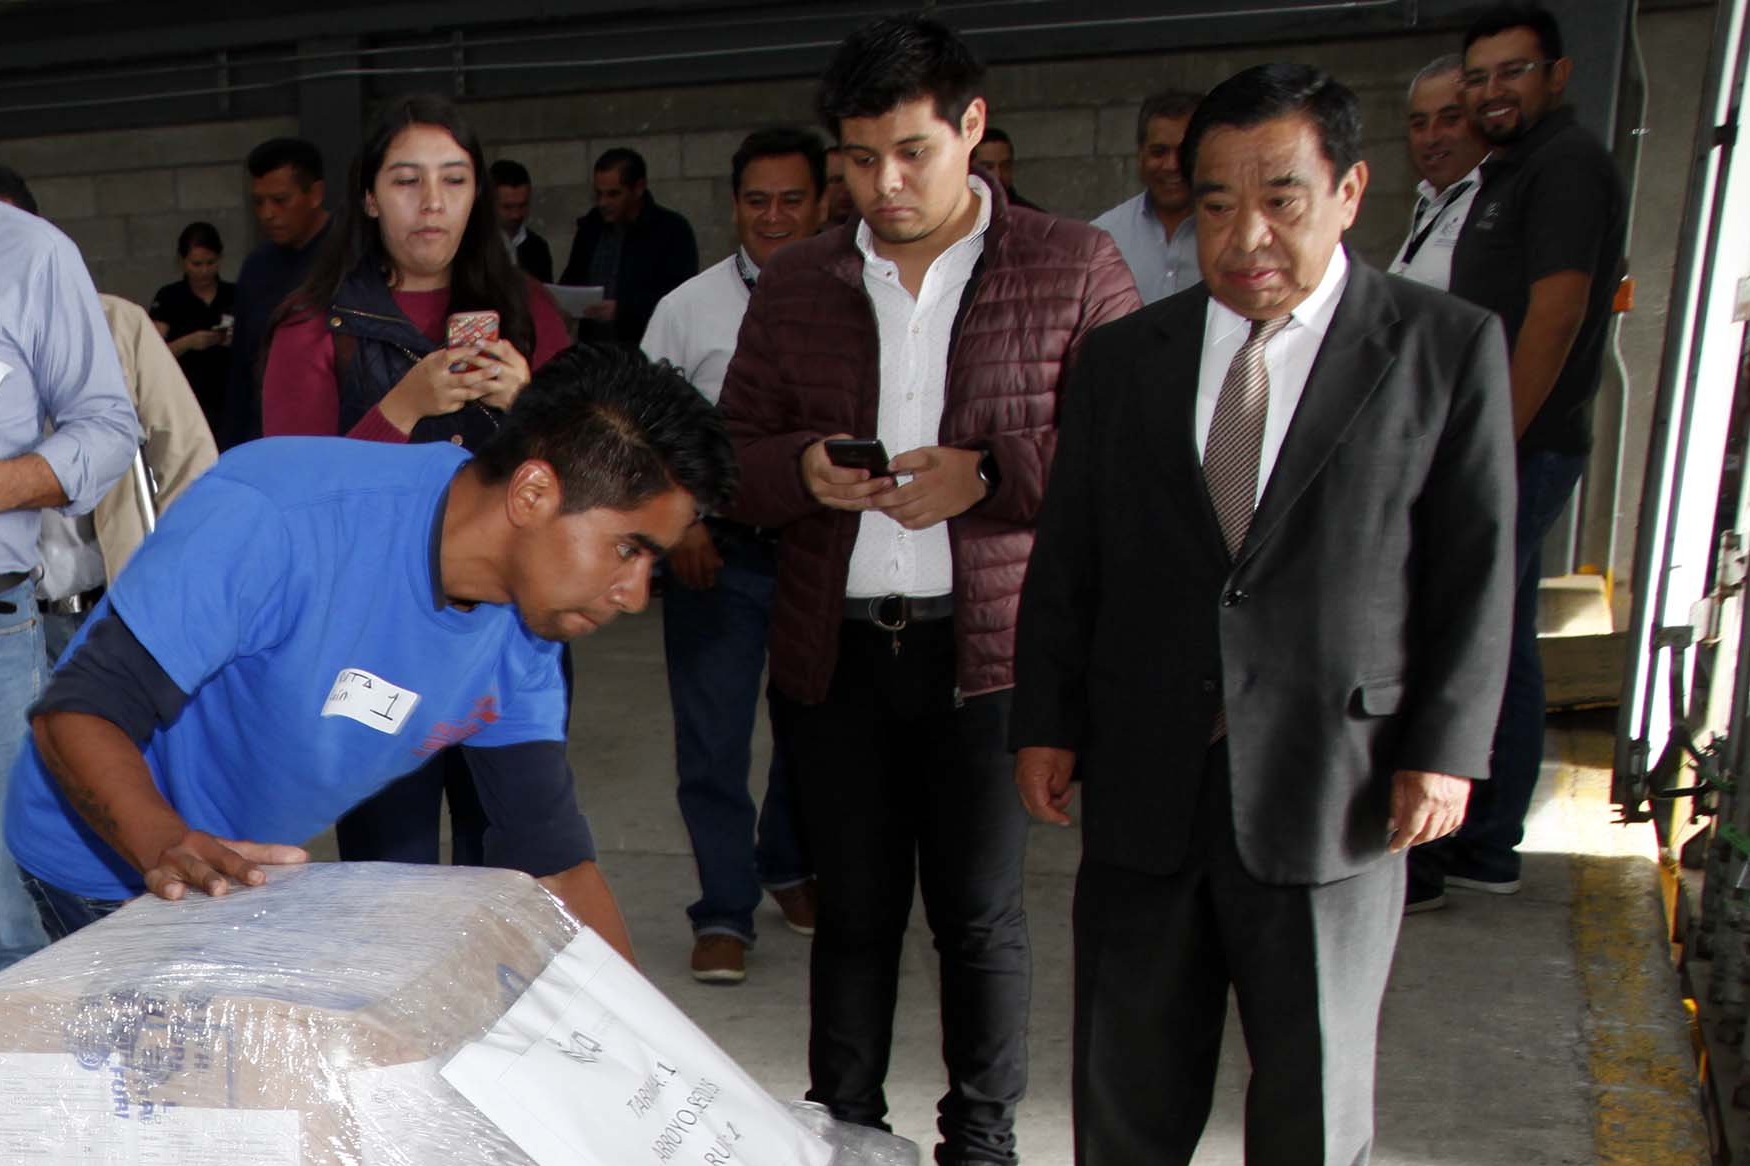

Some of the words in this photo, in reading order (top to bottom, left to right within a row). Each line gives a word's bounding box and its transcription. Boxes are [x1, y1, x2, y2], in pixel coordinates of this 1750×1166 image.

[369, 692, 400, 721] 1
[656, 1062, 677, 1077] 1
[651, 1108, 698, 1165] ARROYO
